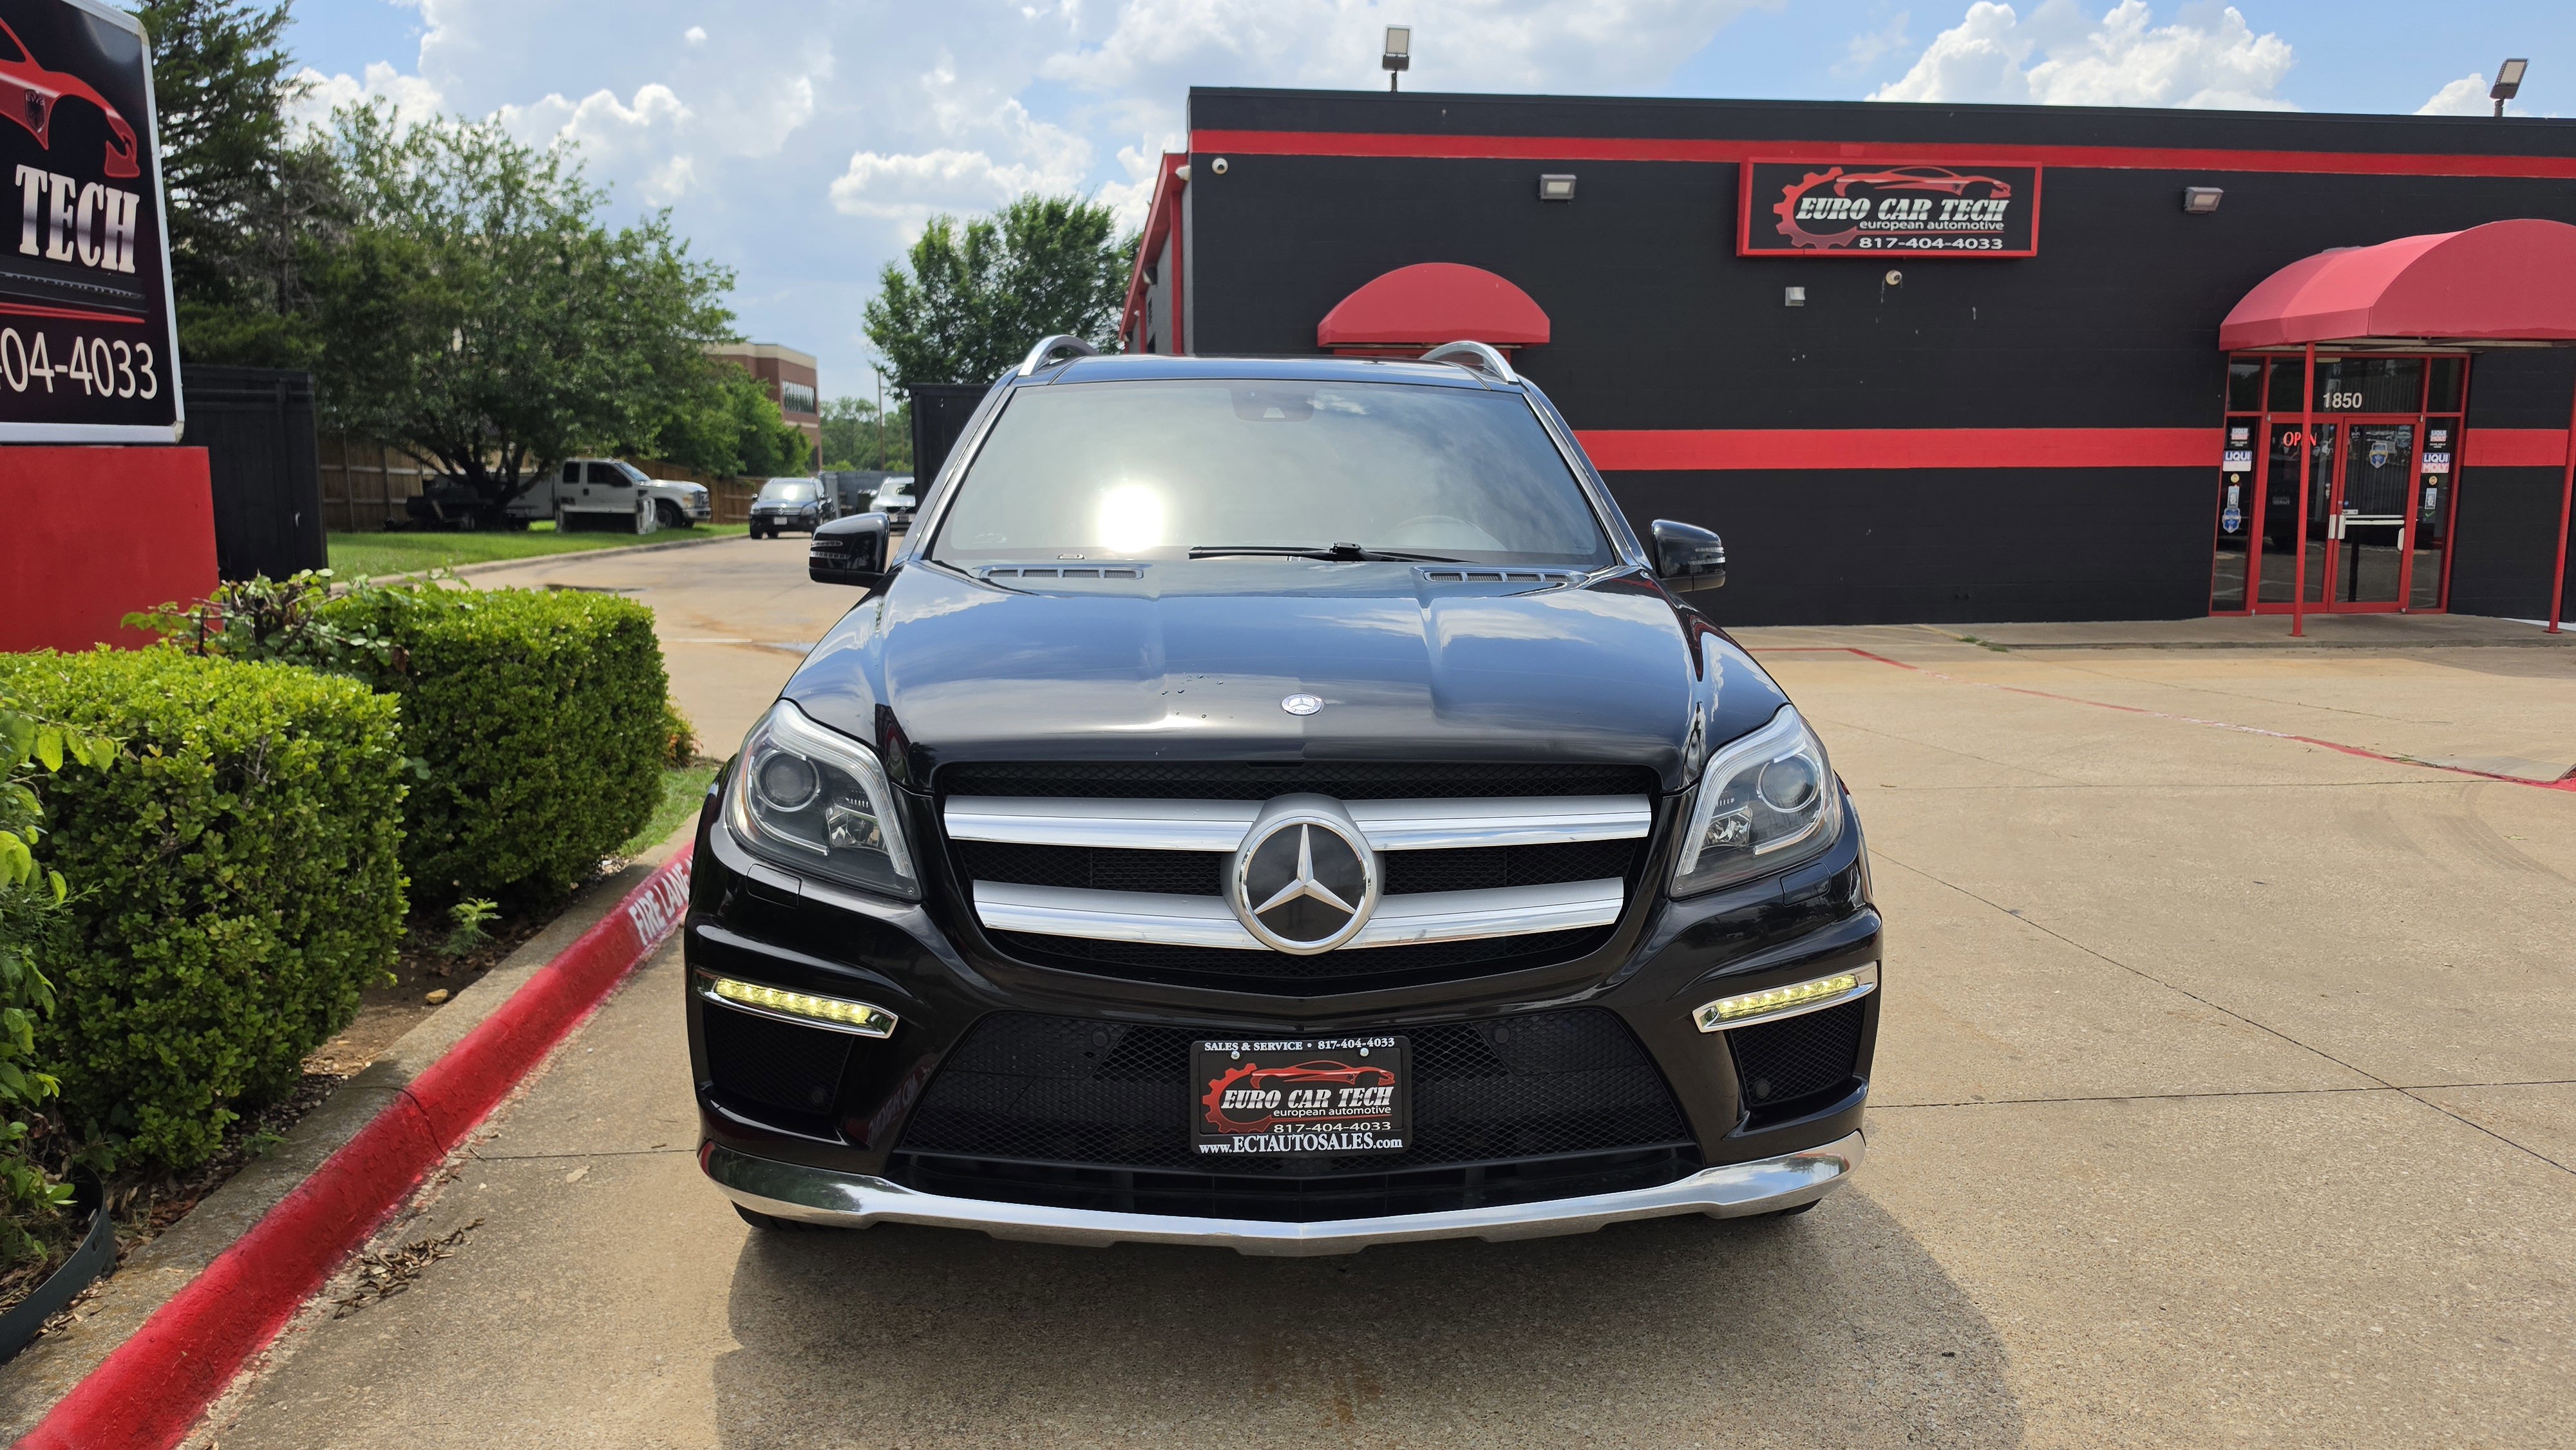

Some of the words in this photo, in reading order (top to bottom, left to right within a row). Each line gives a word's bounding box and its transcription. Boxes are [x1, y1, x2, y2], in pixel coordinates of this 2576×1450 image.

[1795, 197, 1871, 220] EURO
[1877, 198, 1933, 220] CAR
[1938, 199, 2010, 221] TECH
[15, 164, 140, 274] TECH
[1859, 220, 1924, 231] european
[1926, 220, 2005, 231] automotive
[1859, 237, 2003, 250] 817-404-4033
[0, 327, 158, 400] 04-4033
[2323, 392, 2363, 408] 1850
[2283, 431, 2317, 447] OPN
[2225, 451, 2251, 461] LIQUI
[2423, 453, 2448, 463] LIQUI
[628, 890, 666, 946] FIRE
[1204, 1042, 1239, 1051] SALES
[1241, 1042, 1251, 1051] &
[1253, 1042, 1303, 1051] SERVICE
[1318, 1037, 1395, 1050] 817-404-4033
[1221, 1089, 1282, 1109] EURO
[1288, 1089, 1332, 1108] CAR
[1338, 1086, 1394, 1107] TECH
[1273, 1109, 1325, 1118] european
[1328, 1106, 1392, 1116] automotive
[1273, 1122, 1391, 1133] 817-404-4033
[1198, 1132, 1403, 1154] www.ECTAUTOSALES.com
